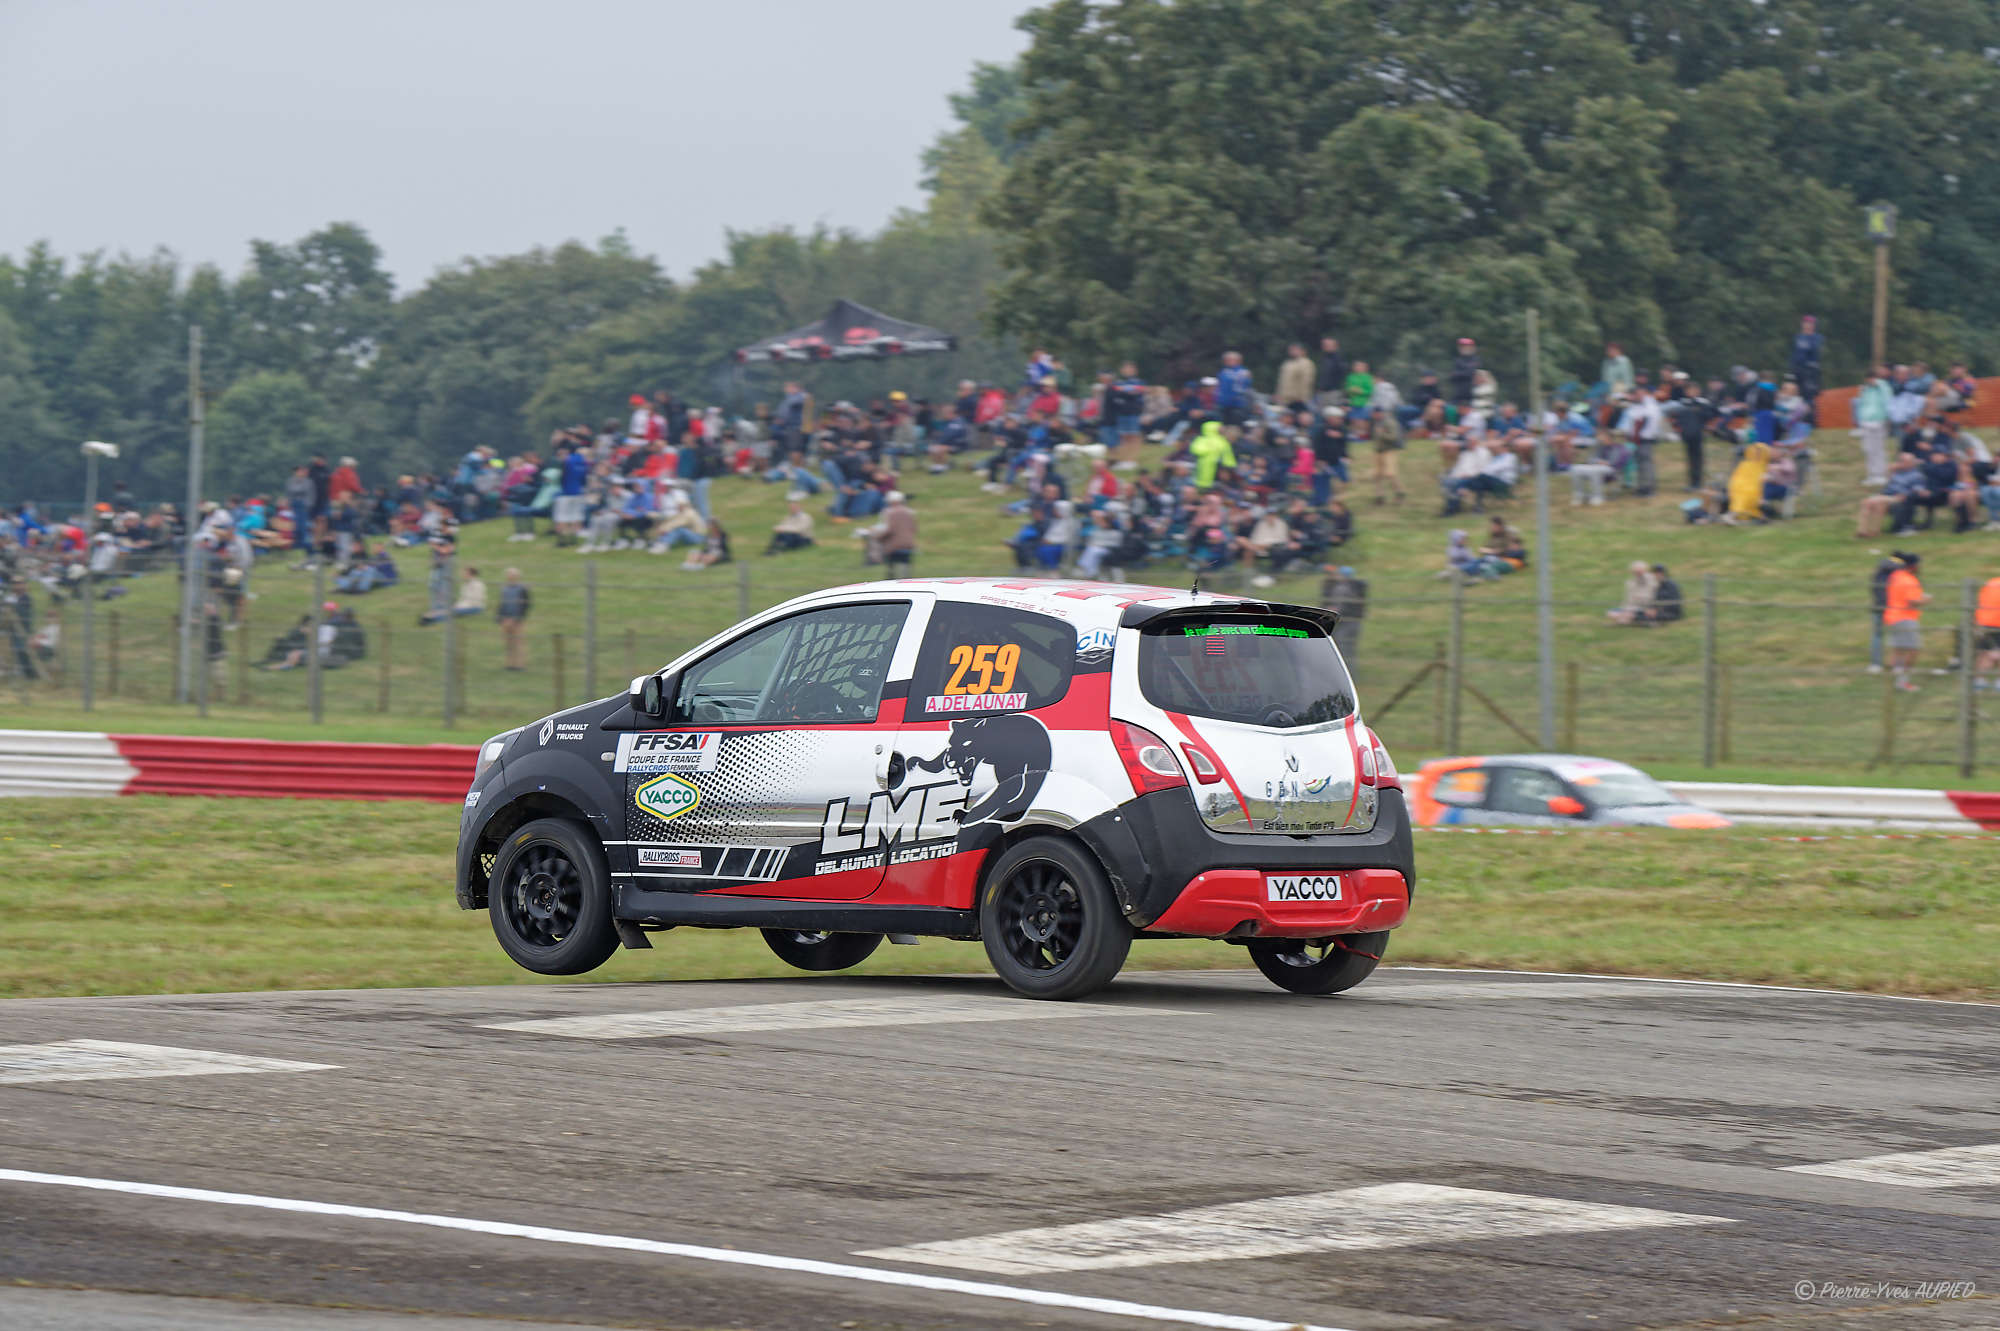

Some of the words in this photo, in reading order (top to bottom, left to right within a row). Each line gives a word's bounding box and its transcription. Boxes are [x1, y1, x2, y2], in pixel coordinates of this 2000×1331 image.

[944, 644, 1021, 695] 259
[927, 694, 1025, 711] A.DELAUNAY
[557, 723, 589, 731] RENAULT
[634, 734, 702, 750] FFSA
[629, 755, 656, 764] COUPE
[657, 755, 669, 763] DE
[670, 755, 702, 763] FRANCE
[645, 790, 693, 804] YACCO
[821, 781, 970, 855] LME
[643, 851, 681, 862] RALLYCROSS
[815, 853, 885, 876] DELAUNAY
[1273, 877, 1337, 900] YACCO
